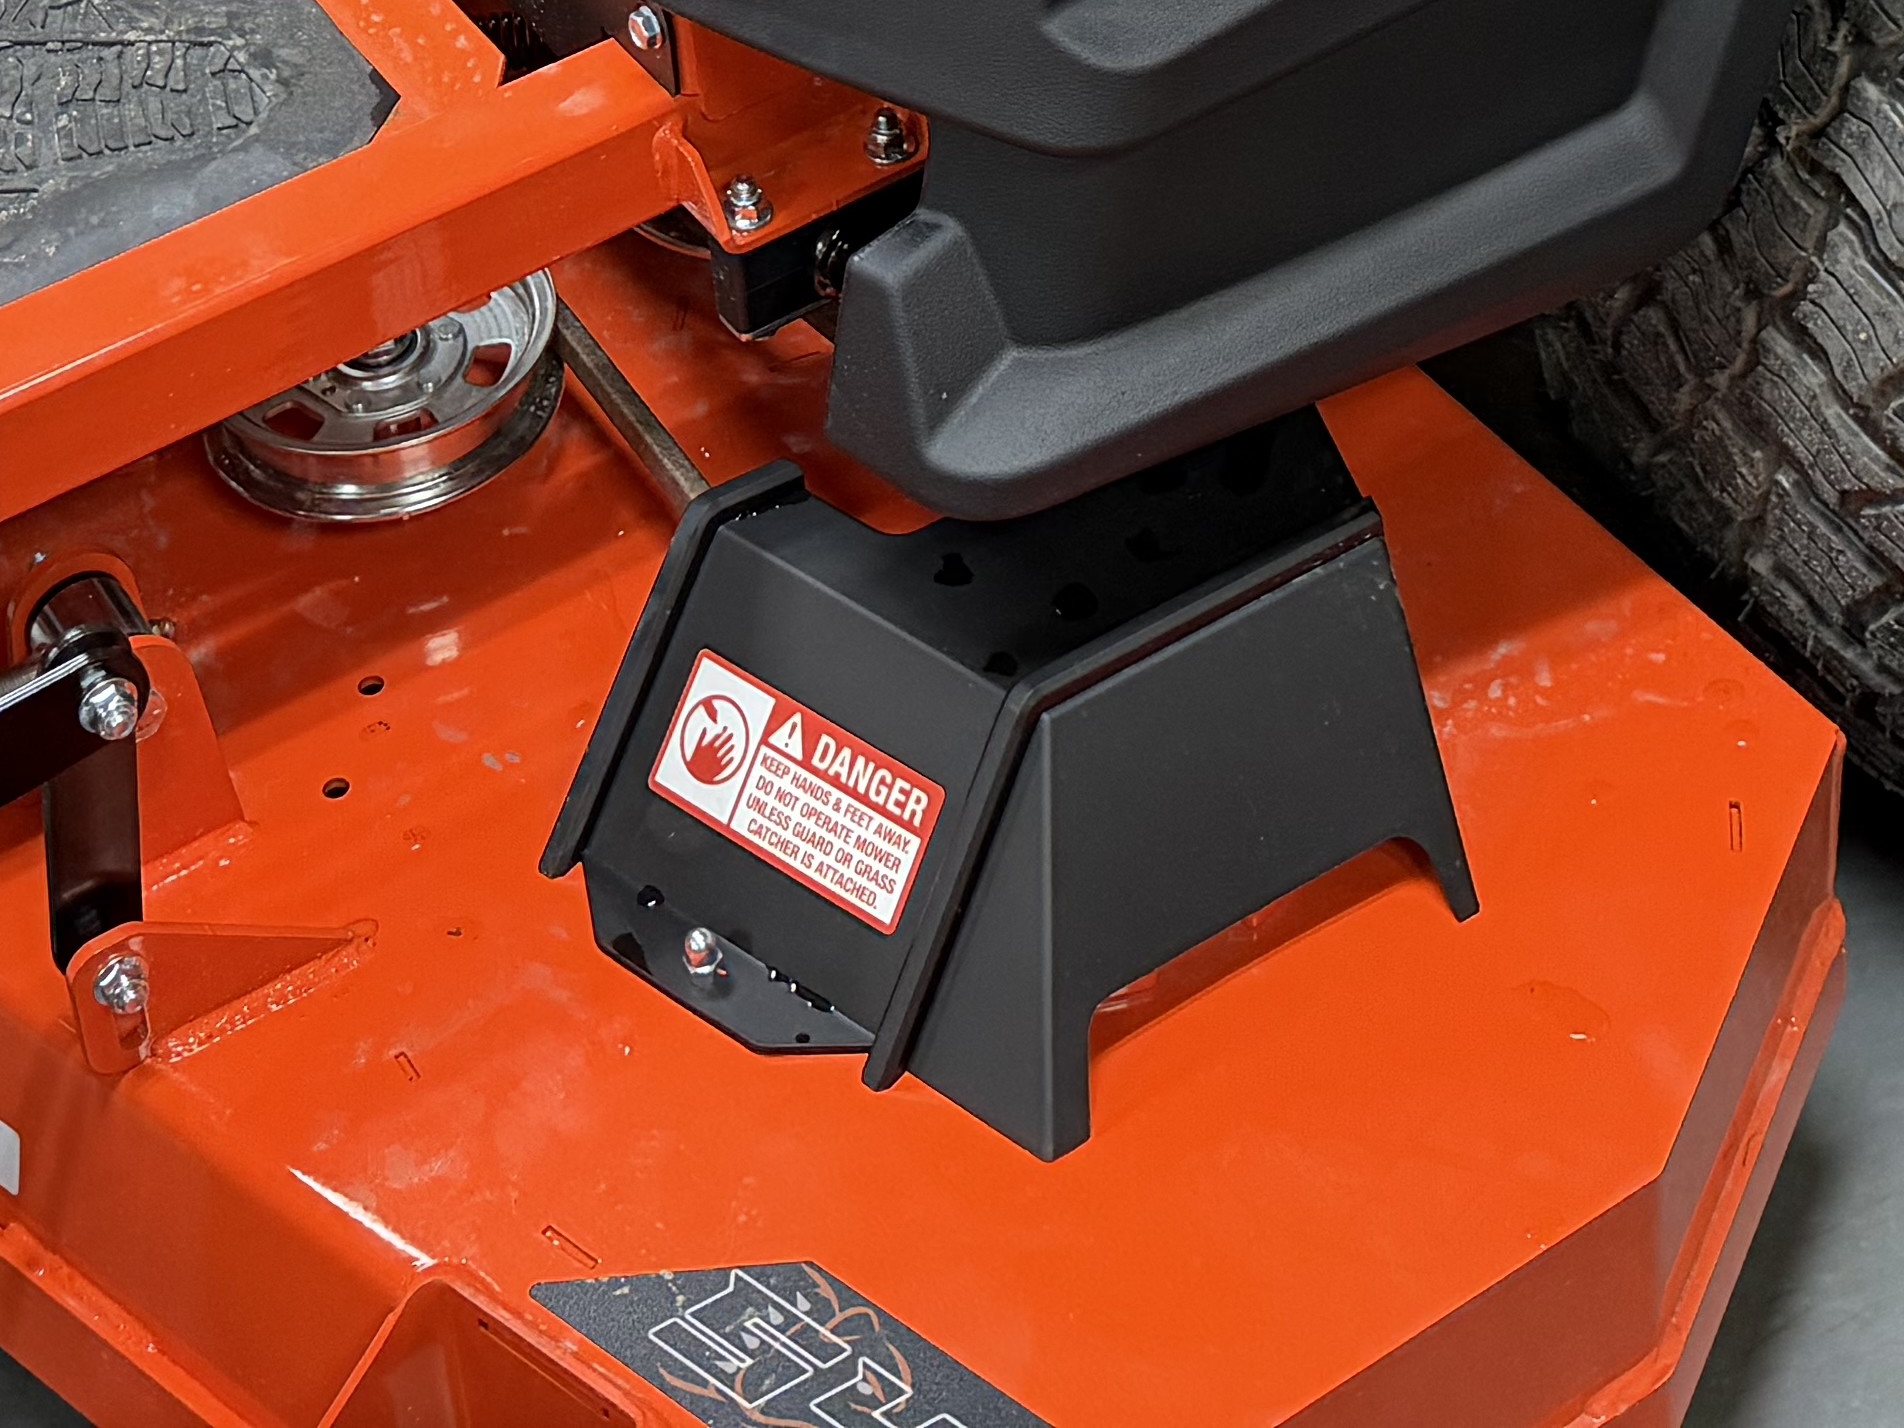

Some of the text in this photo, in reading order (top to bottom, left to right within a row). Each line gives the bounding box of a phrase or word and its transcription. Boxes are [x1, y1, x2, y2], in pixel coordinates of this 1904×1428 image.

[755, 774, 902, 875] DO NOT OPERATE MOWER
[759, 752, 913, 854] KEEP HANDS & FEET AWAY.
[809, 732, 930, 829] DANGER
[746, 795, 897, 895] UNLESS GUARD OR GRASS
[746, 818, 878, 910] CATCHER IS ATTACHED.
